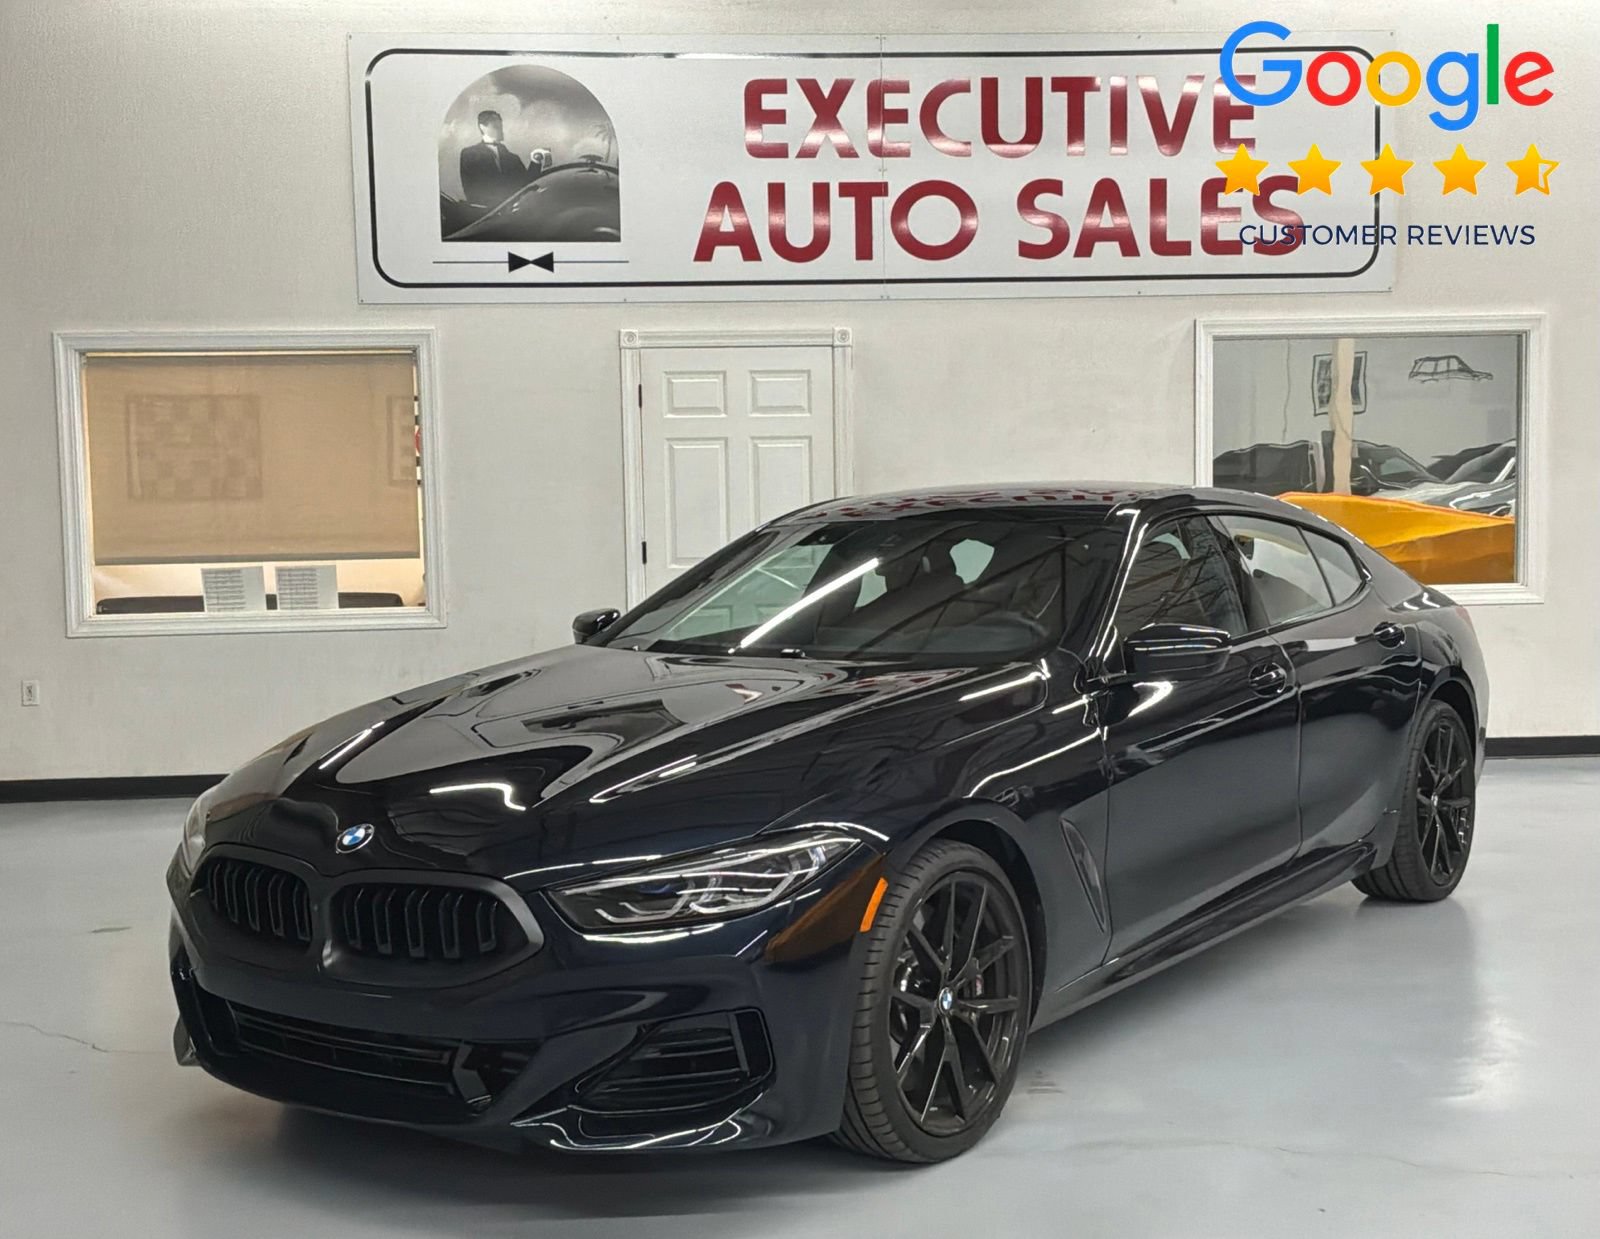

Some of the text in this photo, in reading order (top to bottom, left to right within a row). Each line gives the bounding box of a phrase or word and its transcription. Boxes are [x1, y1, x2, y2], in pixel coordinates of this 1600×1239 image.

[744, 74, 1257, 158] EXECUTIVE
[693, 175, 1306, 263] AUTO SALES
